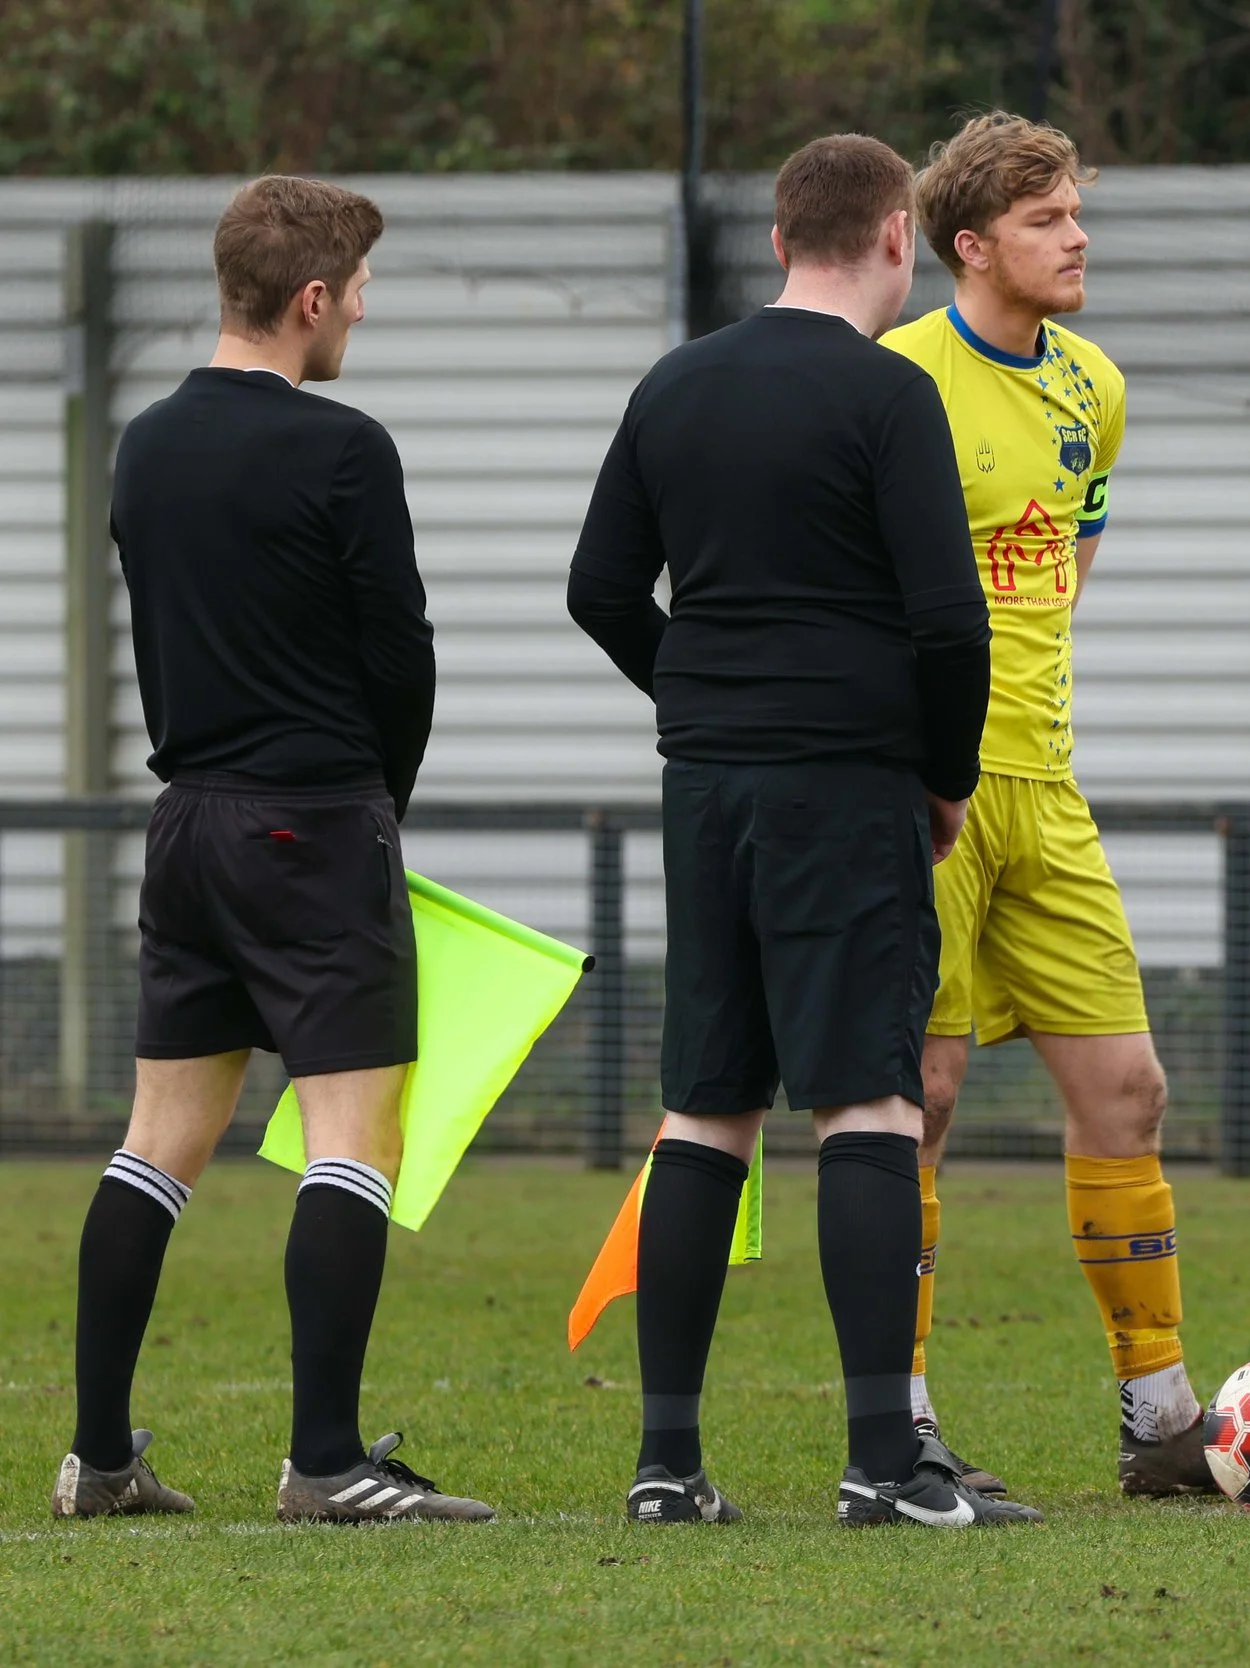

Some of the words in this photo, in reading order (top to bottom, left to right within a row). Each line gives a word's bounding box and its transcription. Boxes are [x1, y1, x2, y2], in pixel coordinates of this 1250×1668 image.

[1061, 428, 1078, 443] SCR
[1078, 427, 1087, 443] FC
[1083, 475, 1108, 513] C
[994, 595, 1025, 606] MORE
[1026, 596, 1051, 607] THAN
[638, 1500, 662, 1514] NIKE
